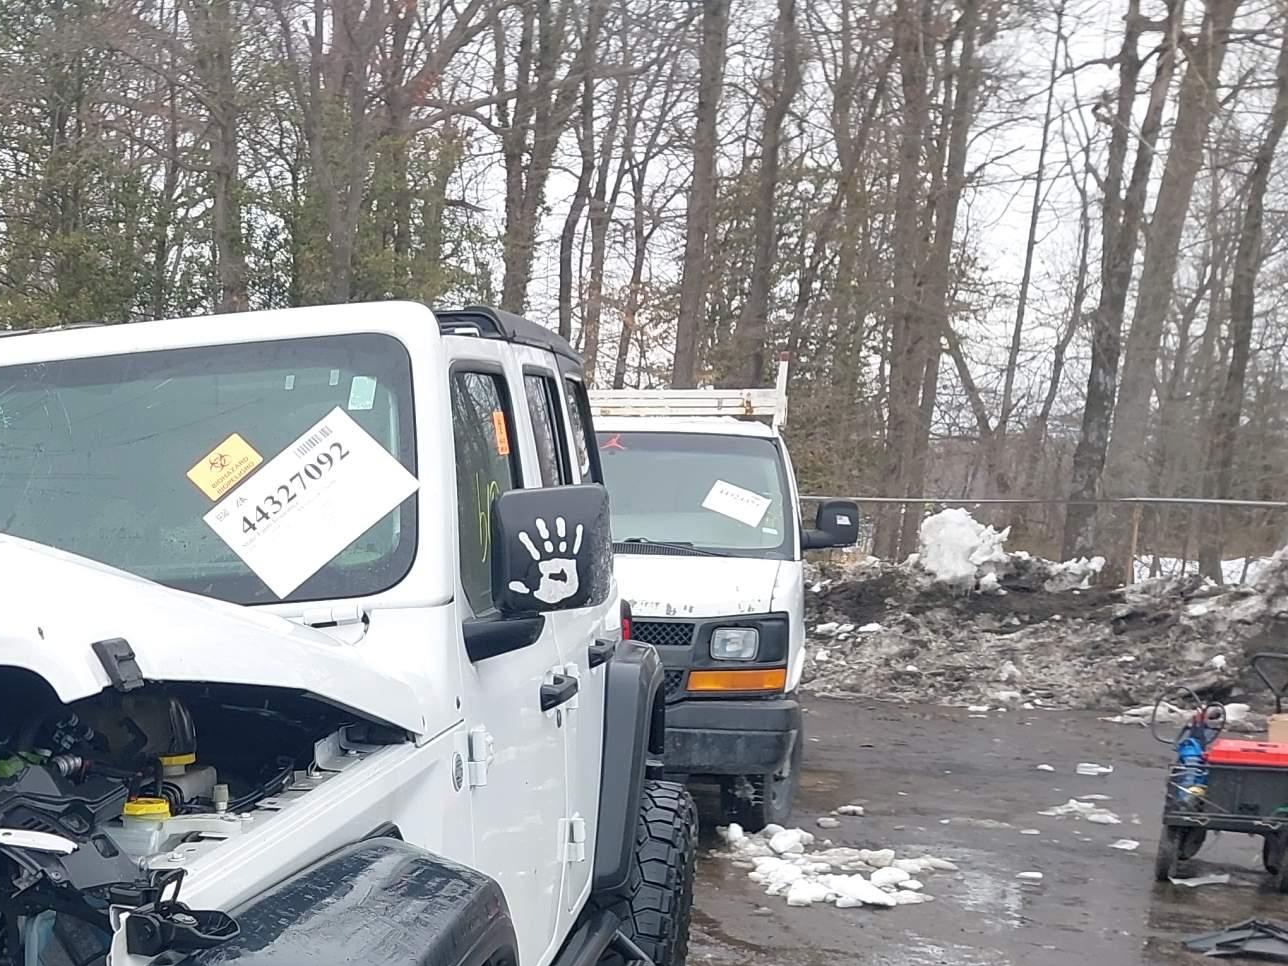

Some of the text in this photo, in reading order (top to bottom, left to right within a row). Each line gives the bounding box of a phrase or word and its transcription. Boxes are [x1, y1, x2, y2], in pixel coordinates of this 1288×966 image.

[212, 457, 249, 488] BIOHAZARD
[217, 462, 255, 494] BIOPELIGRO
[242, 442, 350, 534] 44327092
